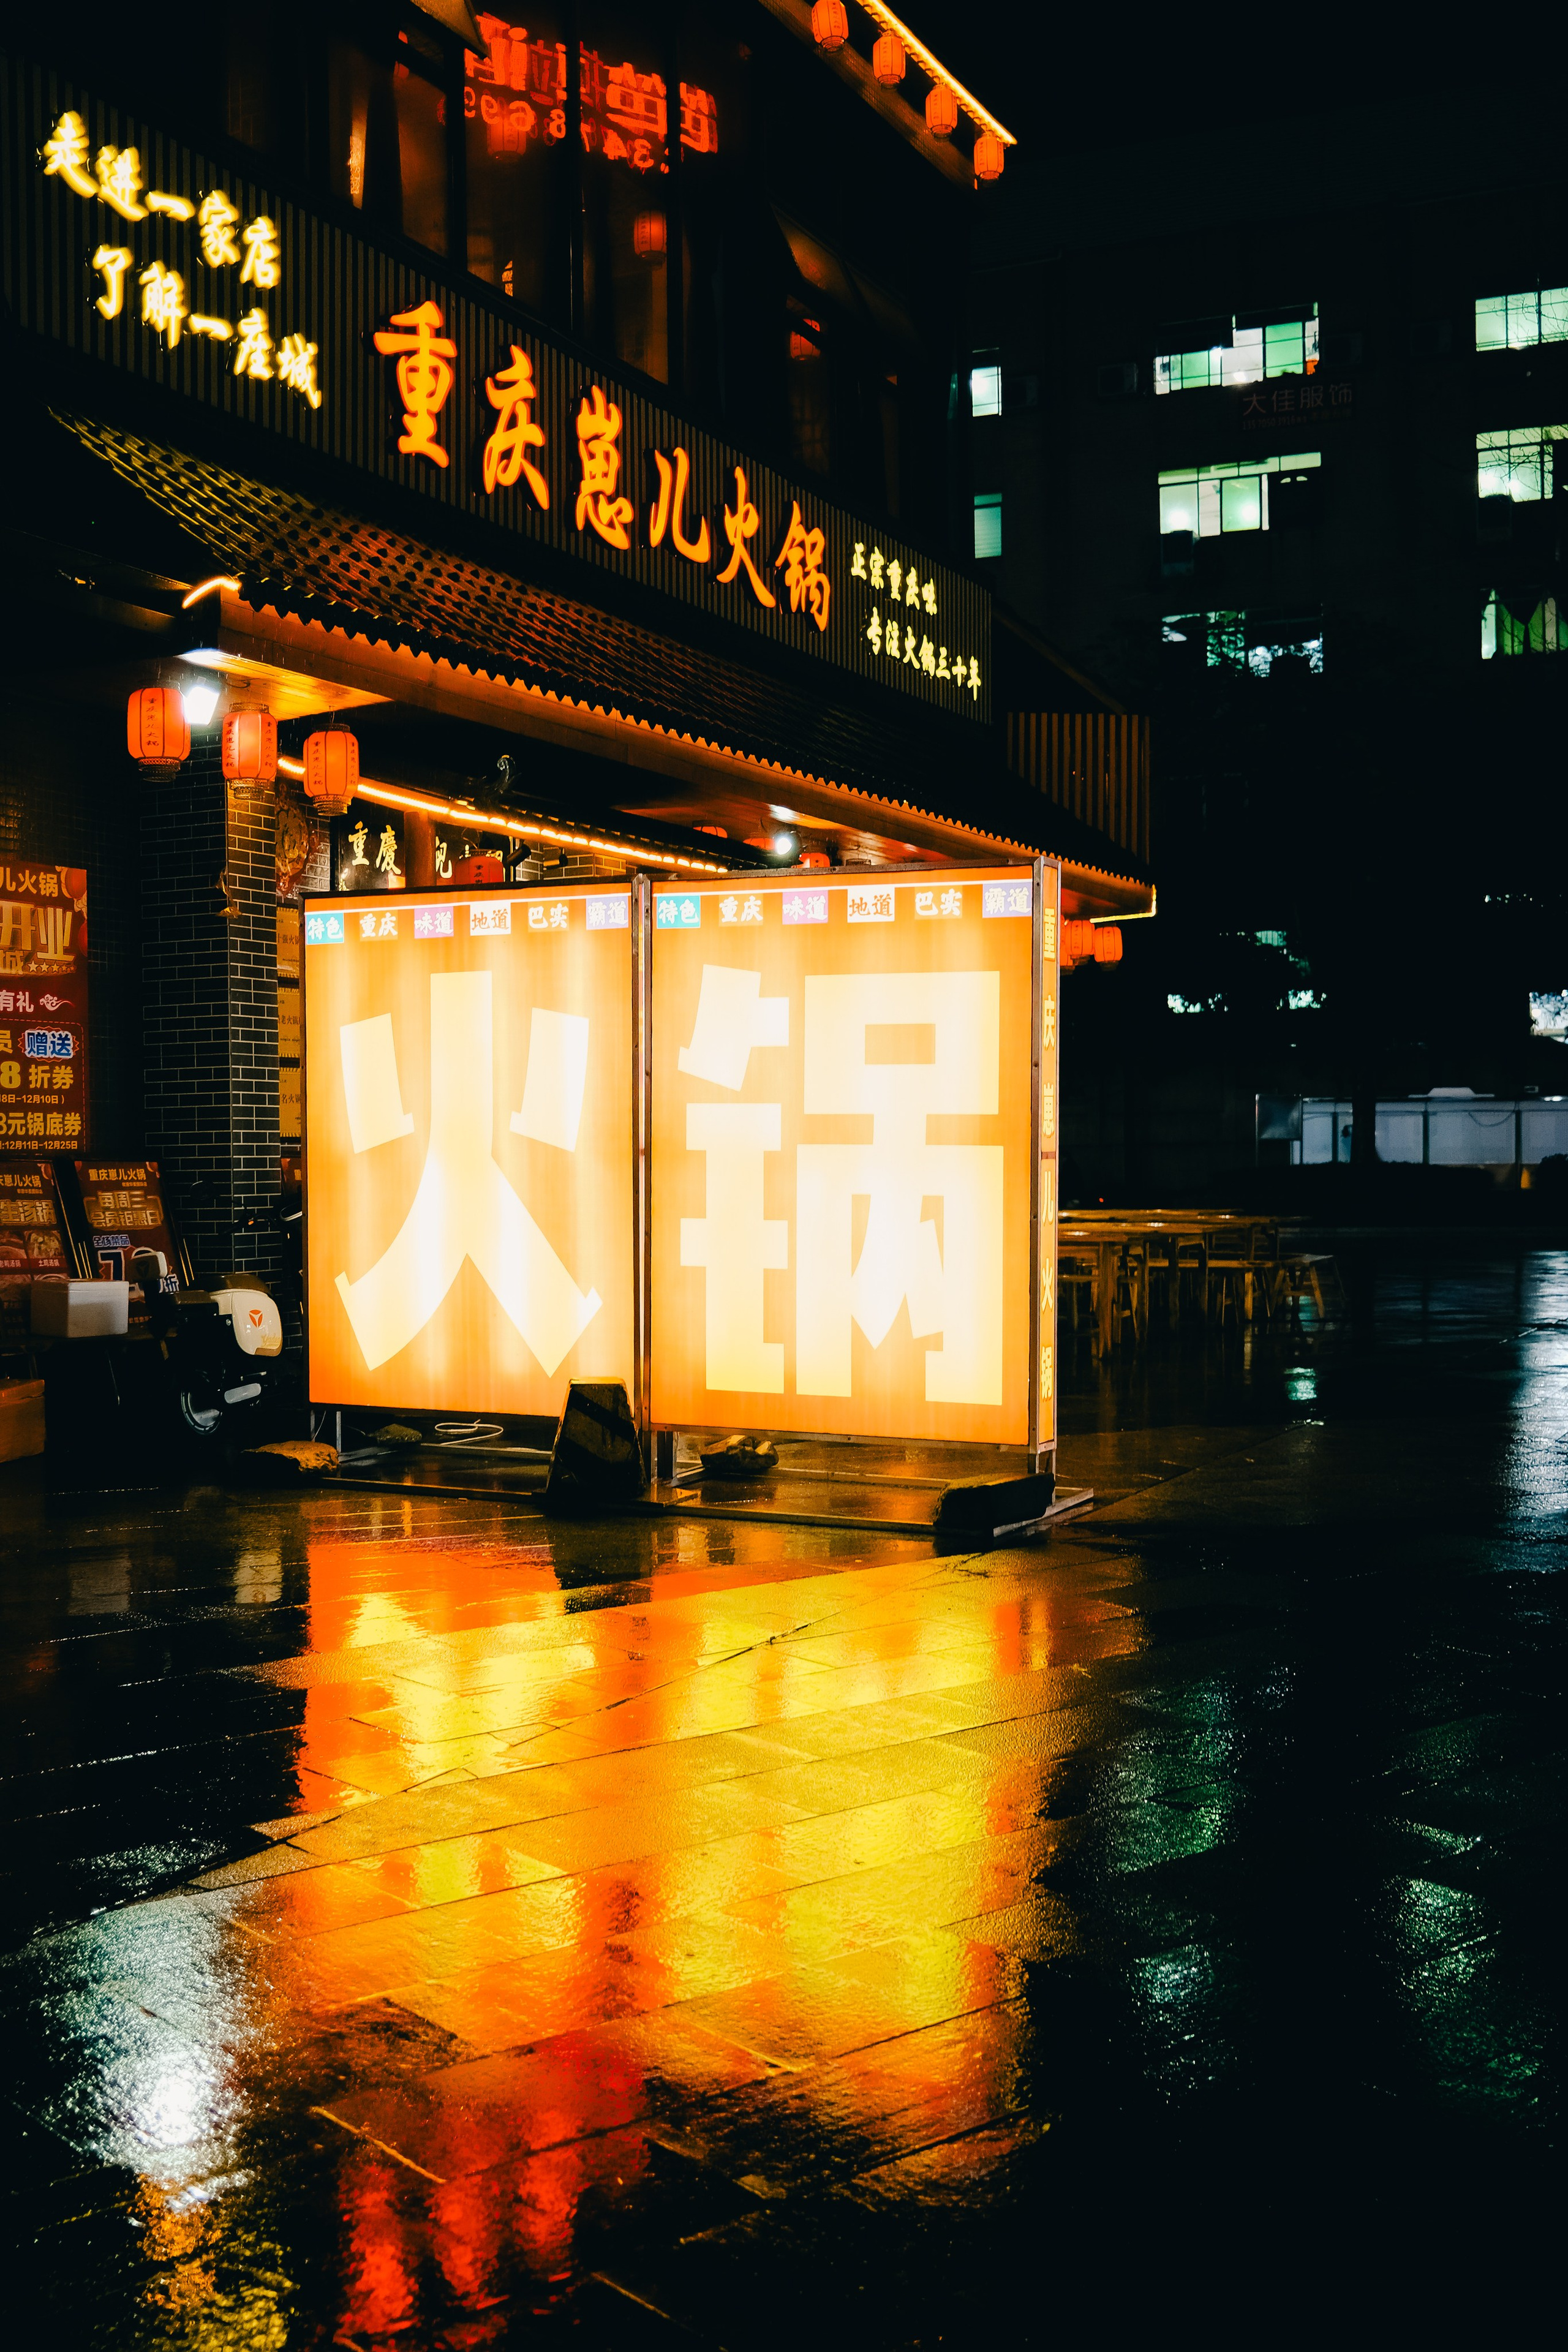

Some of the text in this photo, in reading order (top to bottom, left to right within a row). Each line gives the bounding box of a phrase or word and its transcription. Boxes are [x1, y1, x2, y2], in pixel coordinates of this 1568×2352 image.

[42, 110, 282, 289] 走进一家店
[91, 244, 322, 410] 了解一座城
[1242, 382, 1352, 417] 大佳服饰
[374, 300, 832, 633] 重庆崽儿火锅
[349, 821, 402, 875] 重慶
[307, 900, 627, 941] 特色 重庆 味道 地道 巴实 霸道
[658, 887, 1031, 924] 特色 重庆 味道 地道 巴实 霸道
[0, 989, 34, 1012] 有礼
[27, 1031, 72, 1057] 赠送
[0, 1140, 78, 1150] :12月11日-12月25日
[1041, 907, 1055, 1400] 重庆崽儿火锅
[88, 1168, 146, 1181] 重庆崽儿火锅
